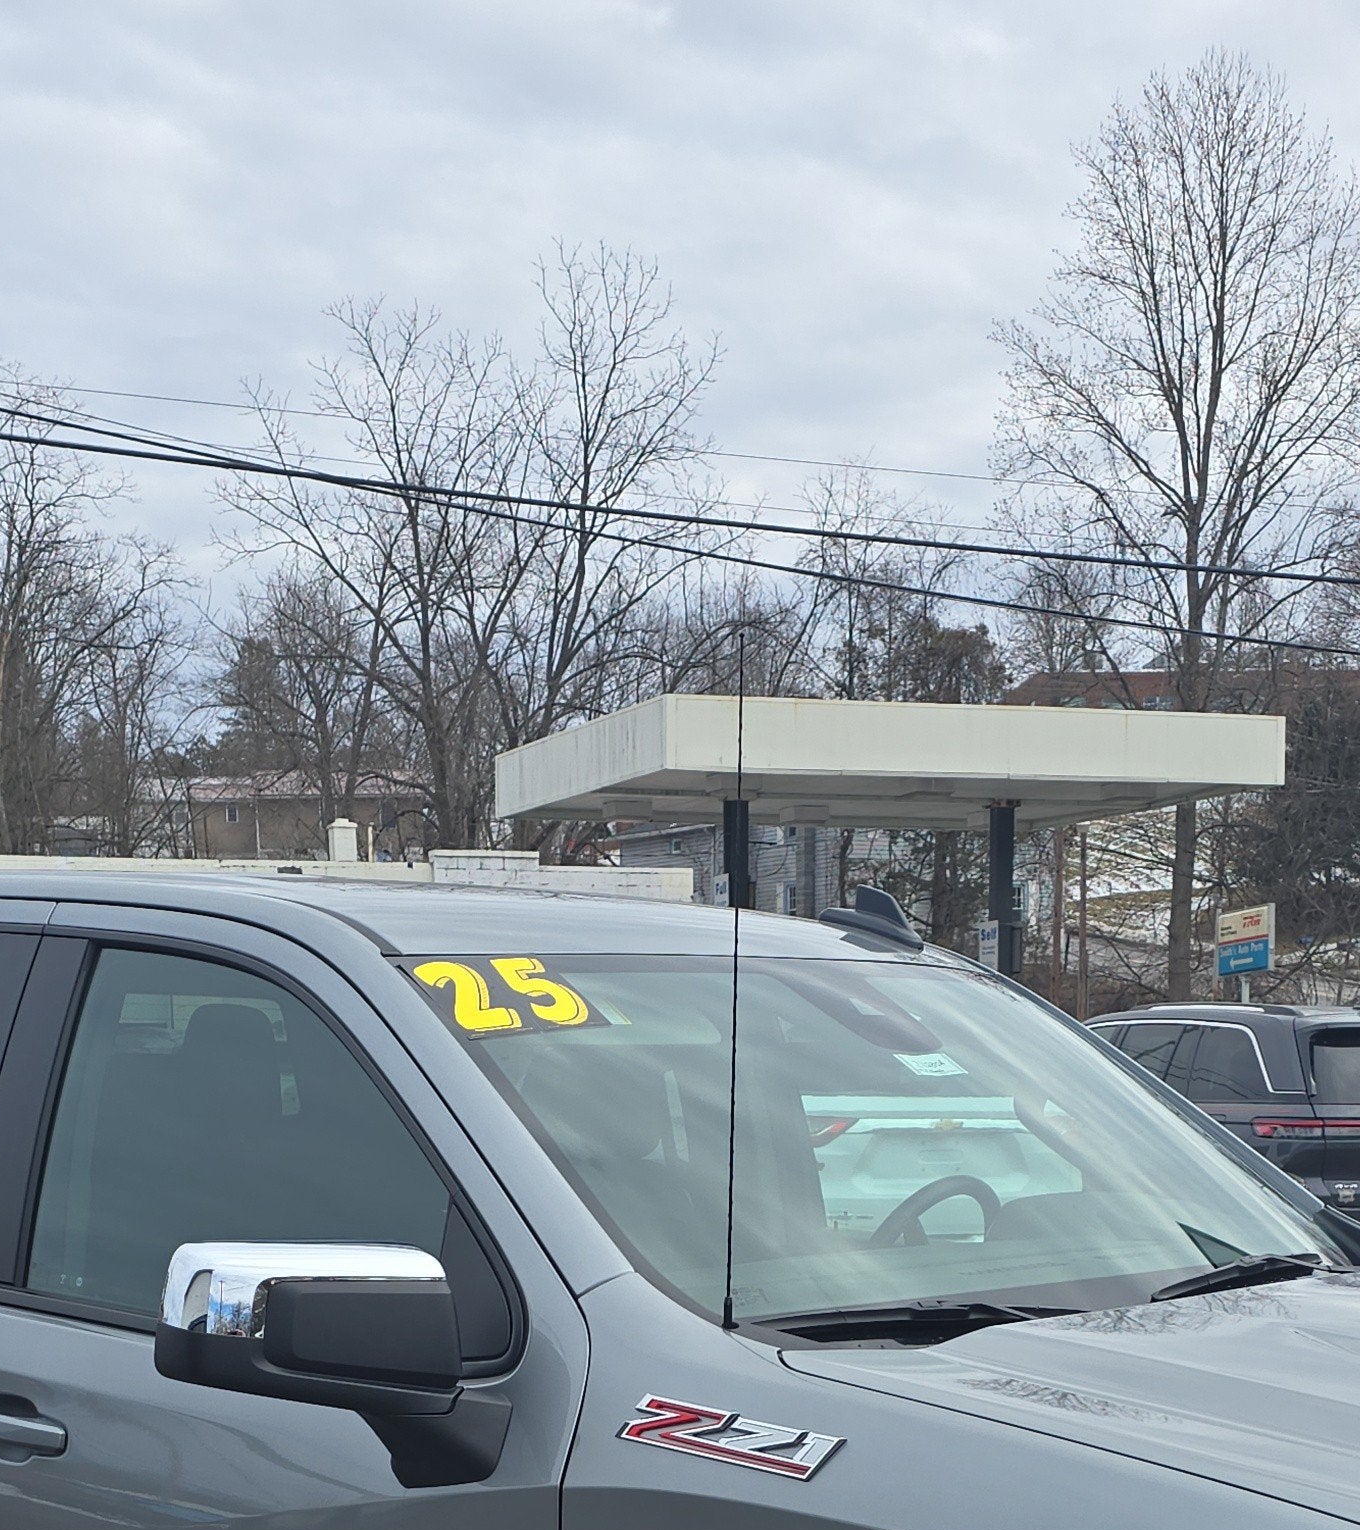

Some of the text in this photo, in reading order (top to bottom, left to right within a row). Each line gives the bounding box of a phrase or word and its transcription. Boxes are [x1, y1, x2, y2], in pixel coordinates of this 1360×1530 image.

[980, 926, 997, 941] Self
[413, 957, 589, 1031] 25
[615, 1392, 848, 1482] Z71
